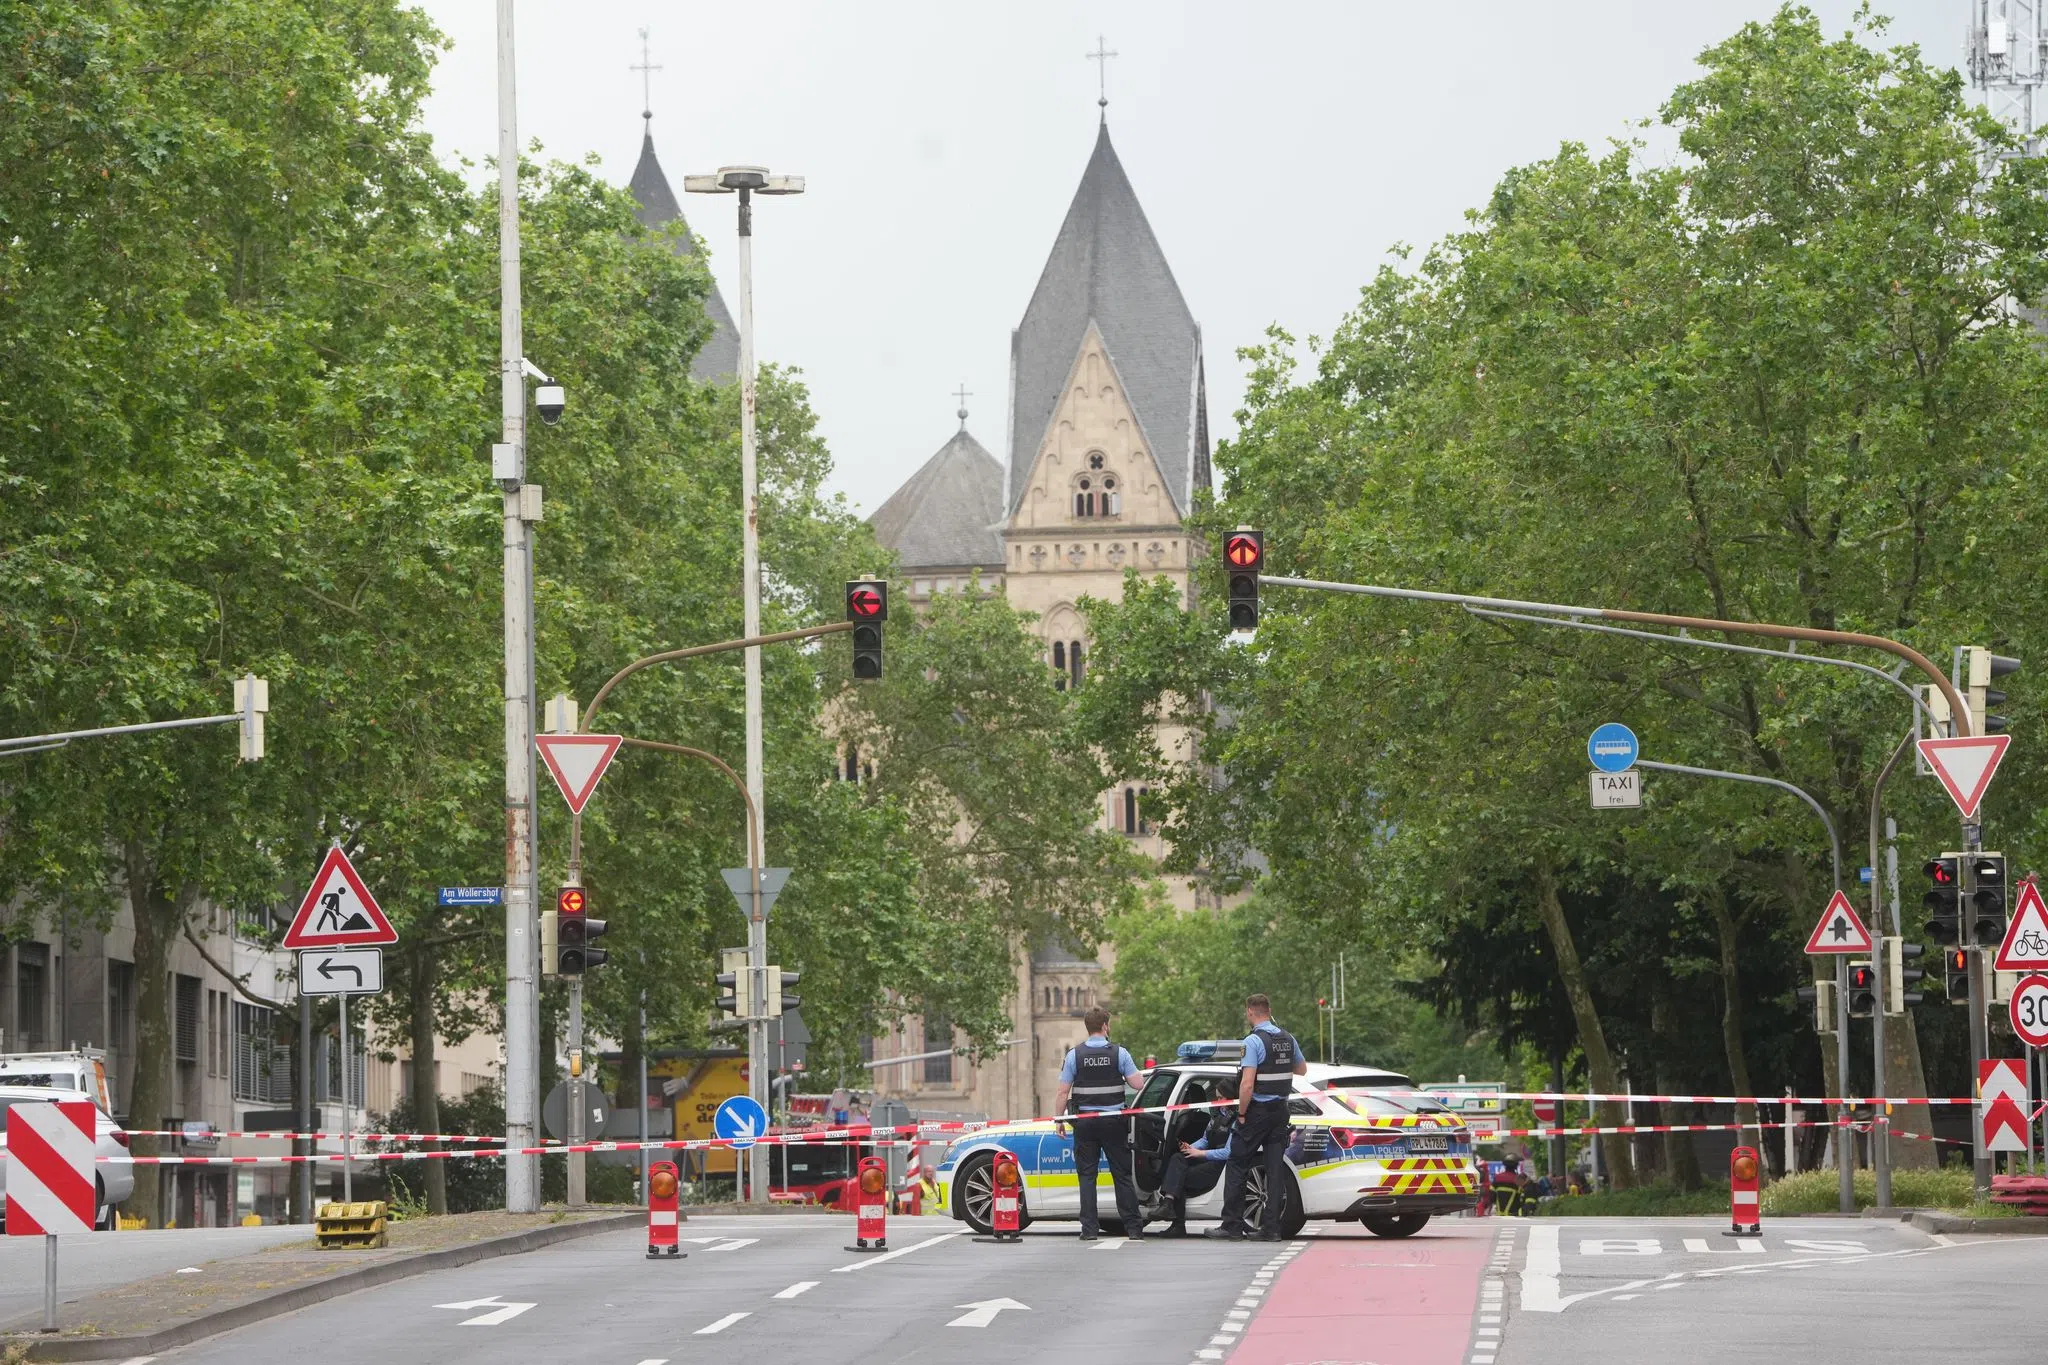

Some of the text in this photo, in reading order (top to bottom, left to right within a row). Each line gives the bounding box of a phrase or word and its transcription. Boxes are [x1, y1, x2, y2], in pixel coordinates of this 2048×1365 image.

[1599, 776, 1632, 790] TAXI
[1609, 796, 1624, 804] frei
[443, 888, 455, 897] Am
[1272, 1042, 1292, 1052] POLIZEI
[1084, 1057, 1111, 1067] POLIZEI
[1377, 1146, 1406, 1155] POLIZEI
[1579, 1238, 1873, 1256] BUS
